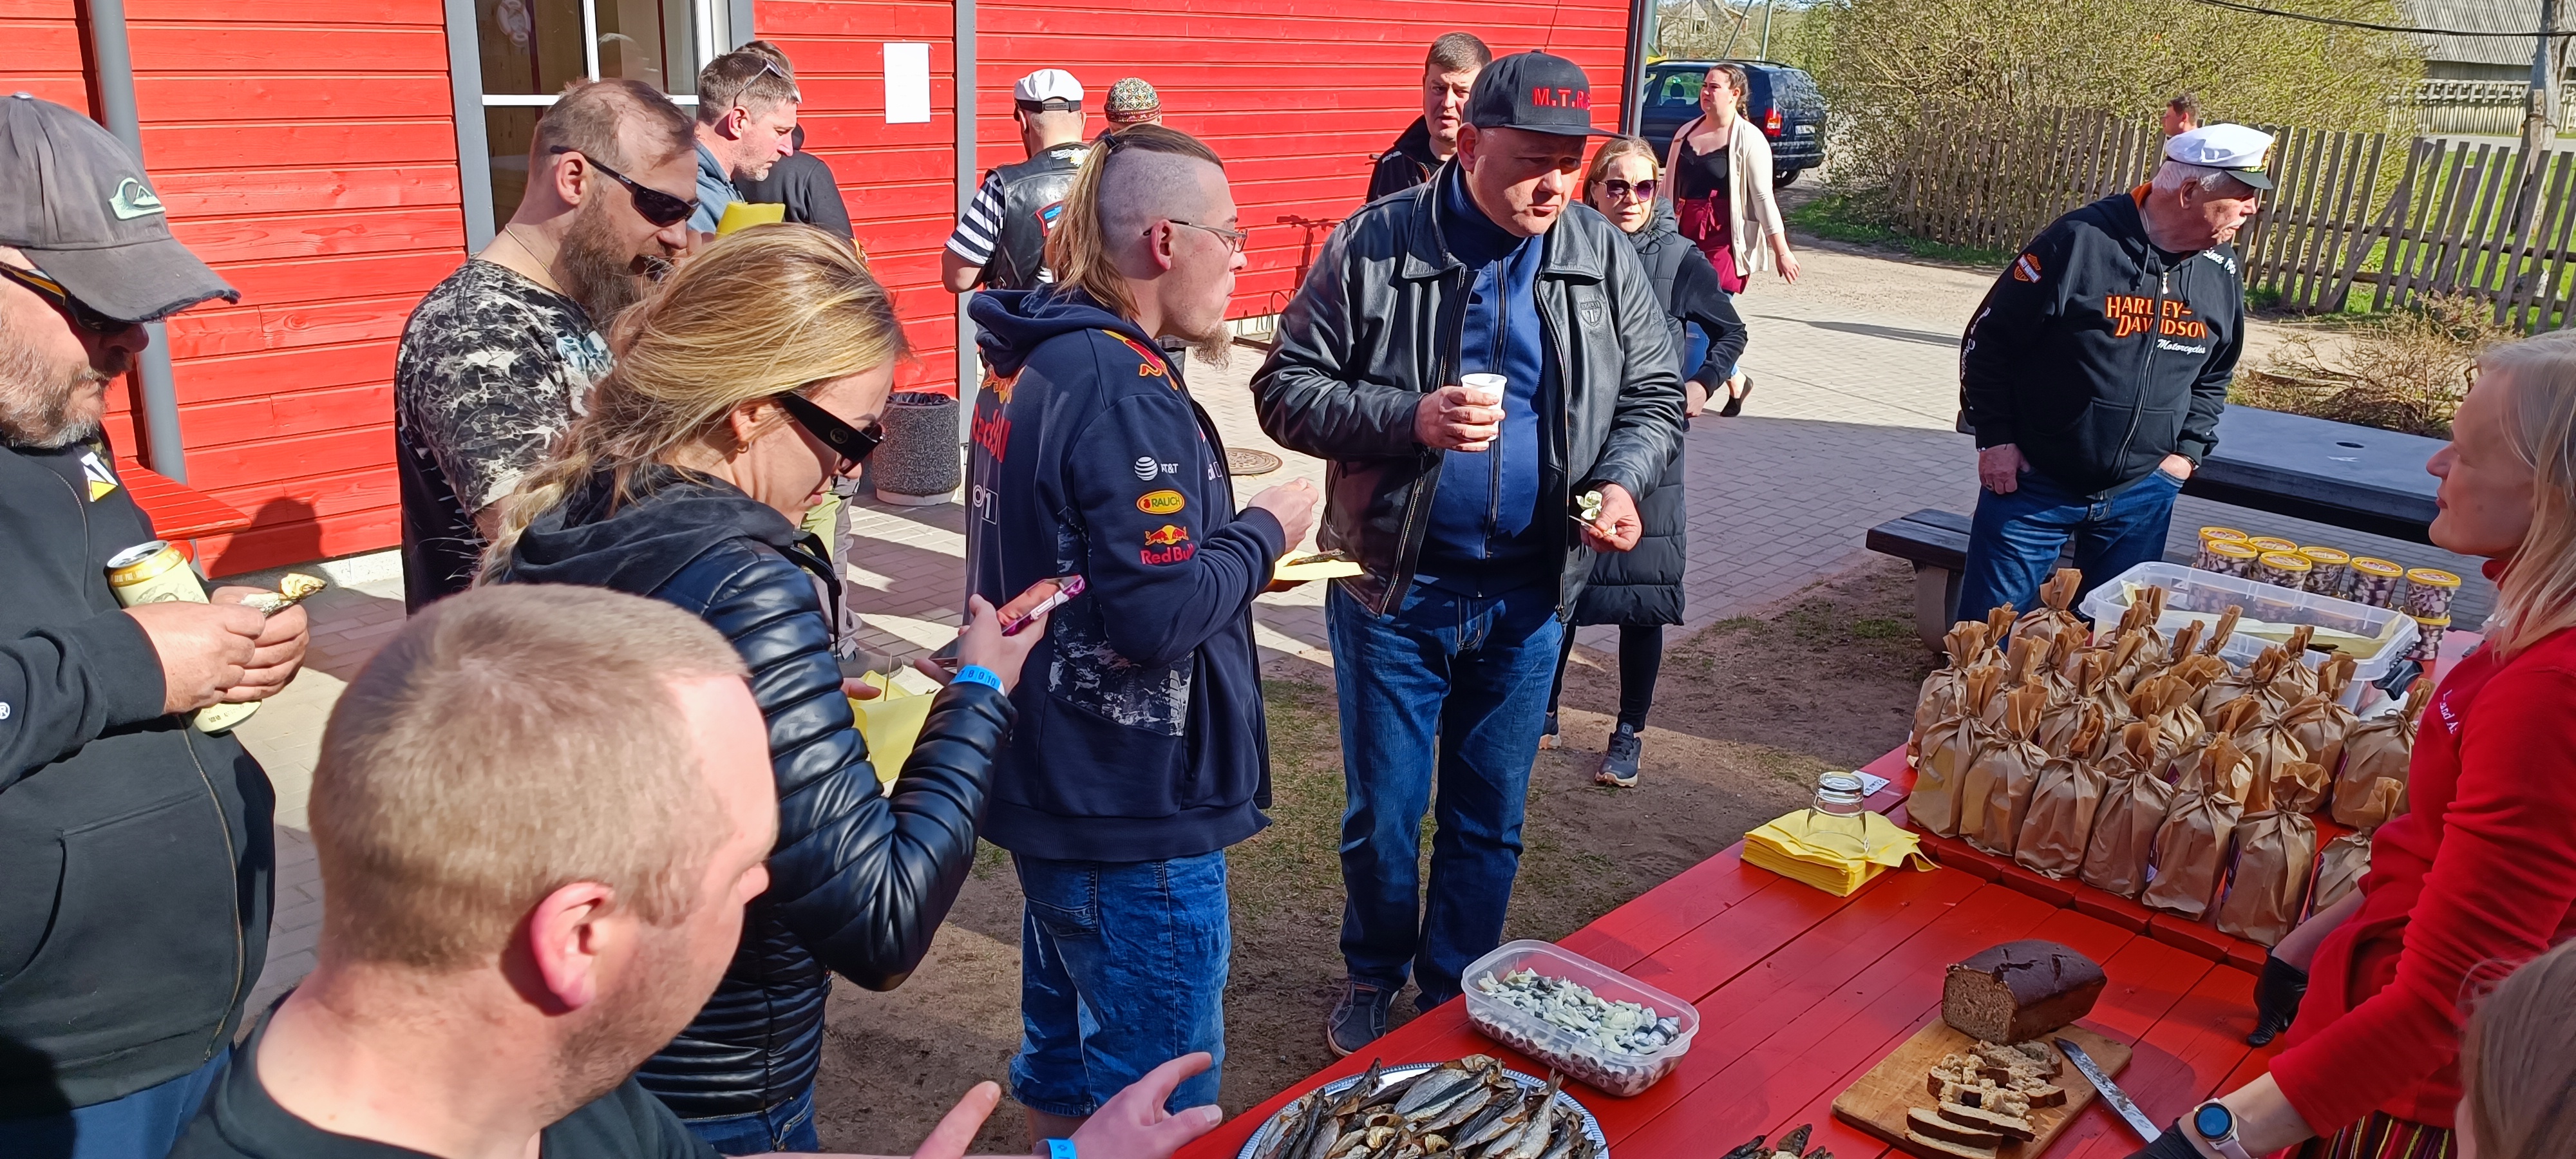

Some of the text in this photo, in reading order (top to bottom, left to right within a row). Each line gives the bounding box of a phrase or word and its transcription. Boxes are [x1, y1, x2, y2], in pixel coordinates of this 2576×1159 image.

[2107, 296, 2192, 319] HARLEY-
[1160, 463, 1179, 474] AT&T
[1151, 496, 1181, 507] RAUCH
[1141, 547, 1171, 565] Red
[968, 670, 975, 678] 8
[987, 675, 996, 687] 10
